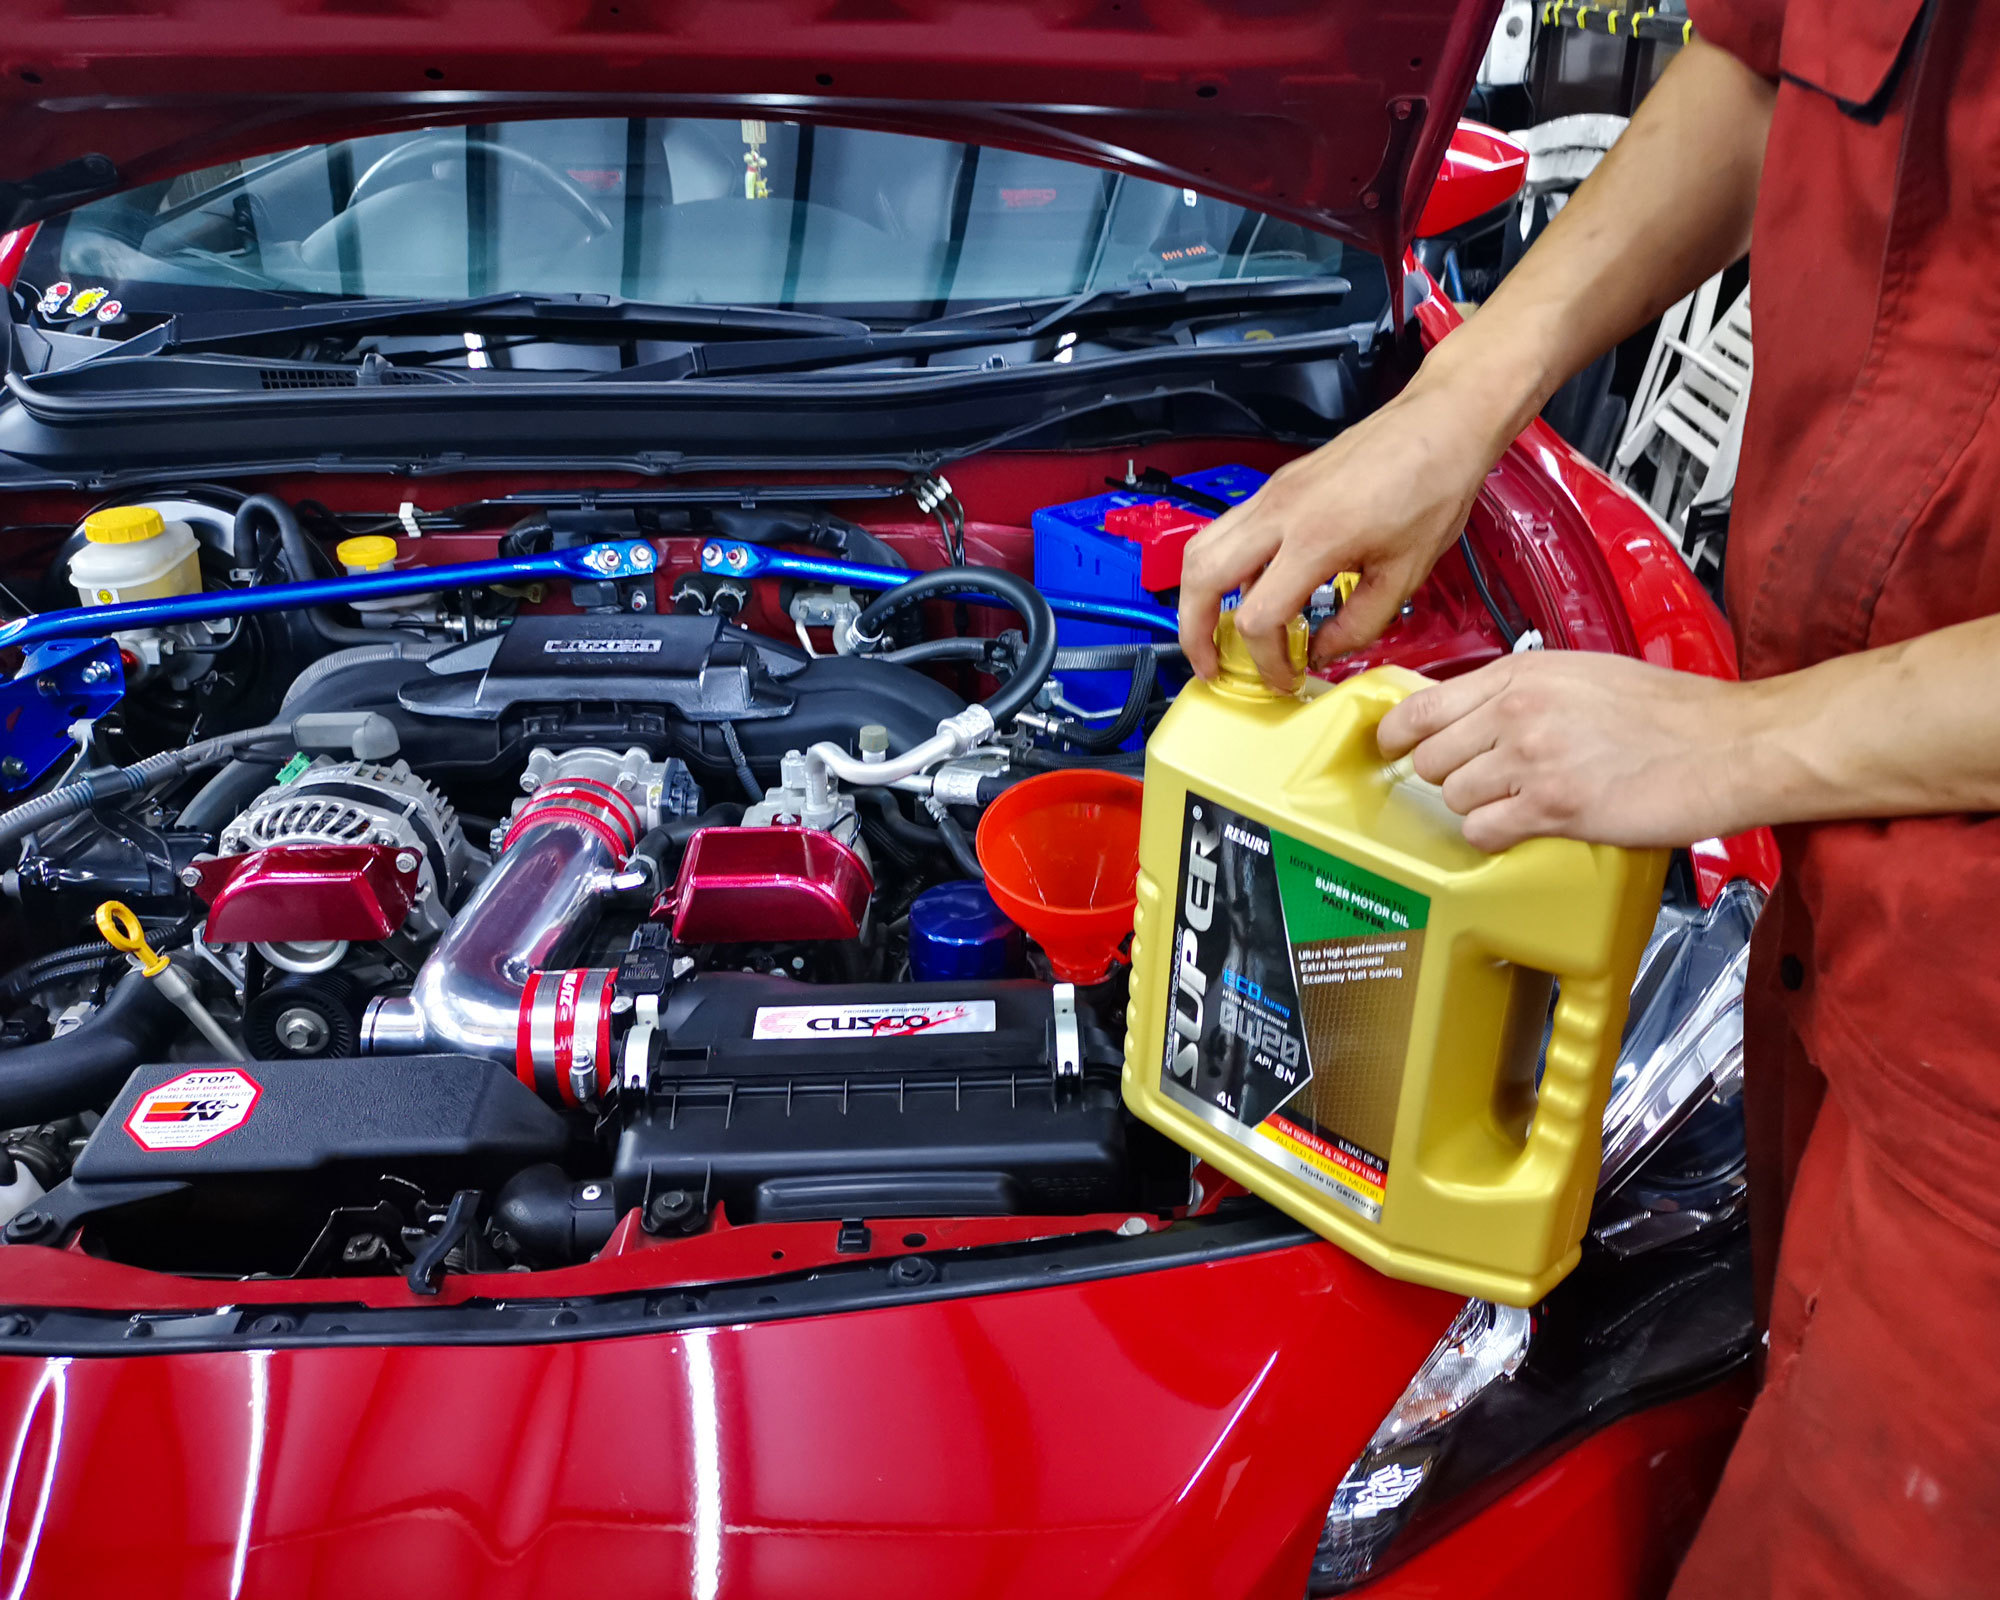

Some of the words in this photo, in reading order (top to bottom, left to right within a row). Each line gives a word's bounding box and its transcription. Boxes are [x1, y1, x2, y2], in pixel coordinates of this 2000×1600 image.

[1224, 823, 1271, 856] RESURS
[1351, 894, 1390, 921] MOTOR
[1392, 911, 1409, 929] OIL
[1172, 821, 1222, 1090] SUPER
[1298, 950, 1321, 962] Ultra
[1323, 946, 1344, 960] high
[1346, 941, 1407, 957] performance
[1300, 961, 1326, 974] Extra
[1327, 955, 1385, 970] horsepower
[1223, 968, 1262, 1001] ECO
[1302, 971, 1345, 985] Economy
[1347, 969, 1367, 981] fuel
[1369, 967, 1403, 979] saving
[806, 1014, 931, 1030] CUSCO
[1254, 1053, 1273, 1070] API
[185, 1075, 236, 1085] STOP!
[1216, 1090, 1236, 1113] 4L
[1299, 1162, 1325, 1183] Made
[1336, 1184, 1378, 1215] Germany
